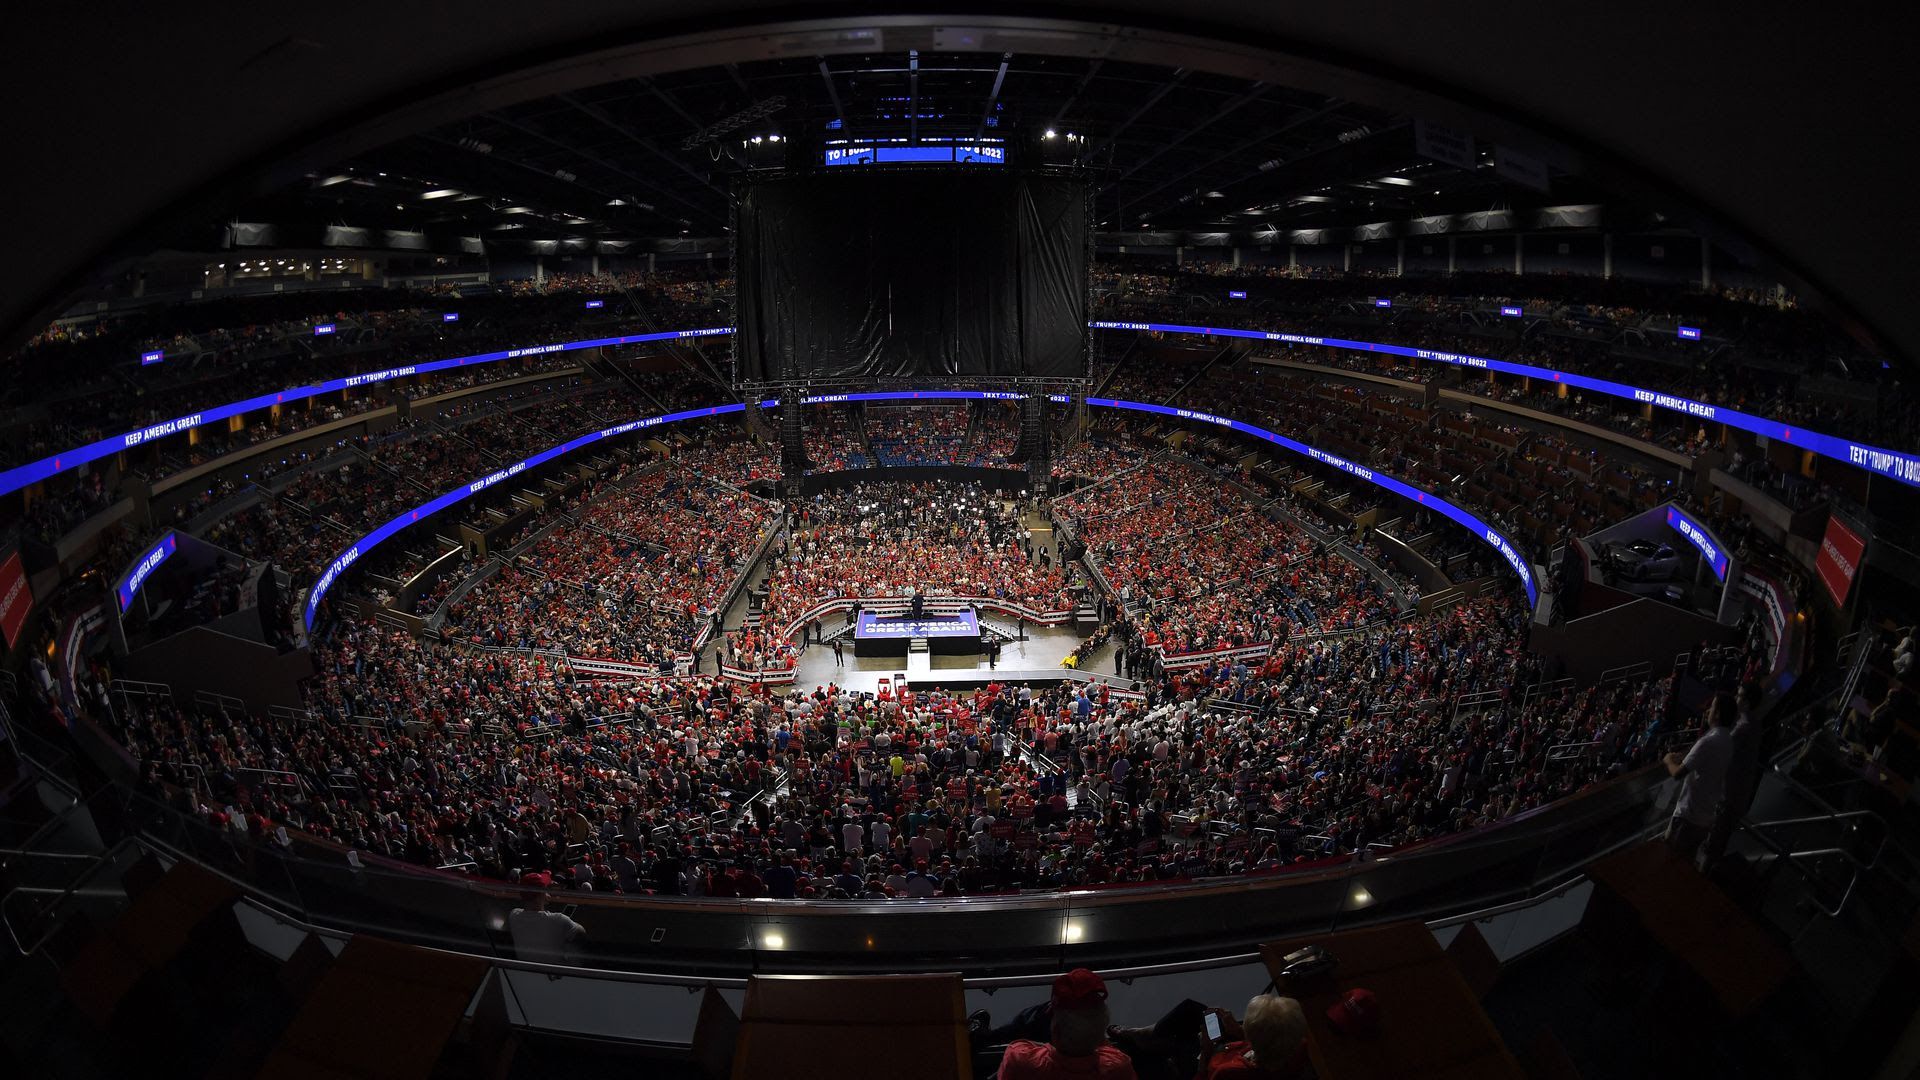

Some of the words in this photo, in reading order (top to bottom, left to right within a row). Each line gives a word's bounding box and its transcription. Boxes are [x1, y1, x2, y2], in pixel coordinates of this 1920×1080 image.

[521, 347, 545, 355] AMERICA
[1281, 334, 1305, 342] AMERICA
[1417, 350, 1431, 358] TEXT
[1431, 352, 1457, 362] "TRUMP"
[1458, 356, 1467, 364] TO
[1467, 358, 1487, 368] 88022
[345, 376, 362, 386] TEXT
[362, 371, 389, 382] "TRUMP"
[390, 369, 398, 377] TO
[399, 366, 416, 376] 88022
[1192, 412, 1215, 422] AMERICA
[1634, 389, 1655, 402] KEEP
[1655, 394, 1687, 411] AMERICA
[1688, 402, 1715, 418] GREAT!
[125, 431, 142, 446] KEEP
[144, 422, 176, 440] AMERICA
[176, 414, 201, 429] GREAT!
[601, 428, 613, 437] TEXT
[1308, 448, 1321, 459] TEXT
[1321, 453, 1345, 467] "TRUMP"
[1346, 462, 1354, 472] TO
[1354, 466, 1373, 480] 88022
[1849, 445, 1868, 466] TEXT
[1868, 451, 1894, 473] "TRUMP"
[1894, 456, 1904, 477] TO
[470, 480, 485, 493] KEEP
[485, 470, 509, 486] AMERICA
[508, 462, 526, 475] GREAT!
[333, 560, 342, 574] TO
[341, 547, 359, 567] 88022
[1486, 530, 1501, 547] KEEP
[1501, 541, 1519, 569] AMERICA
